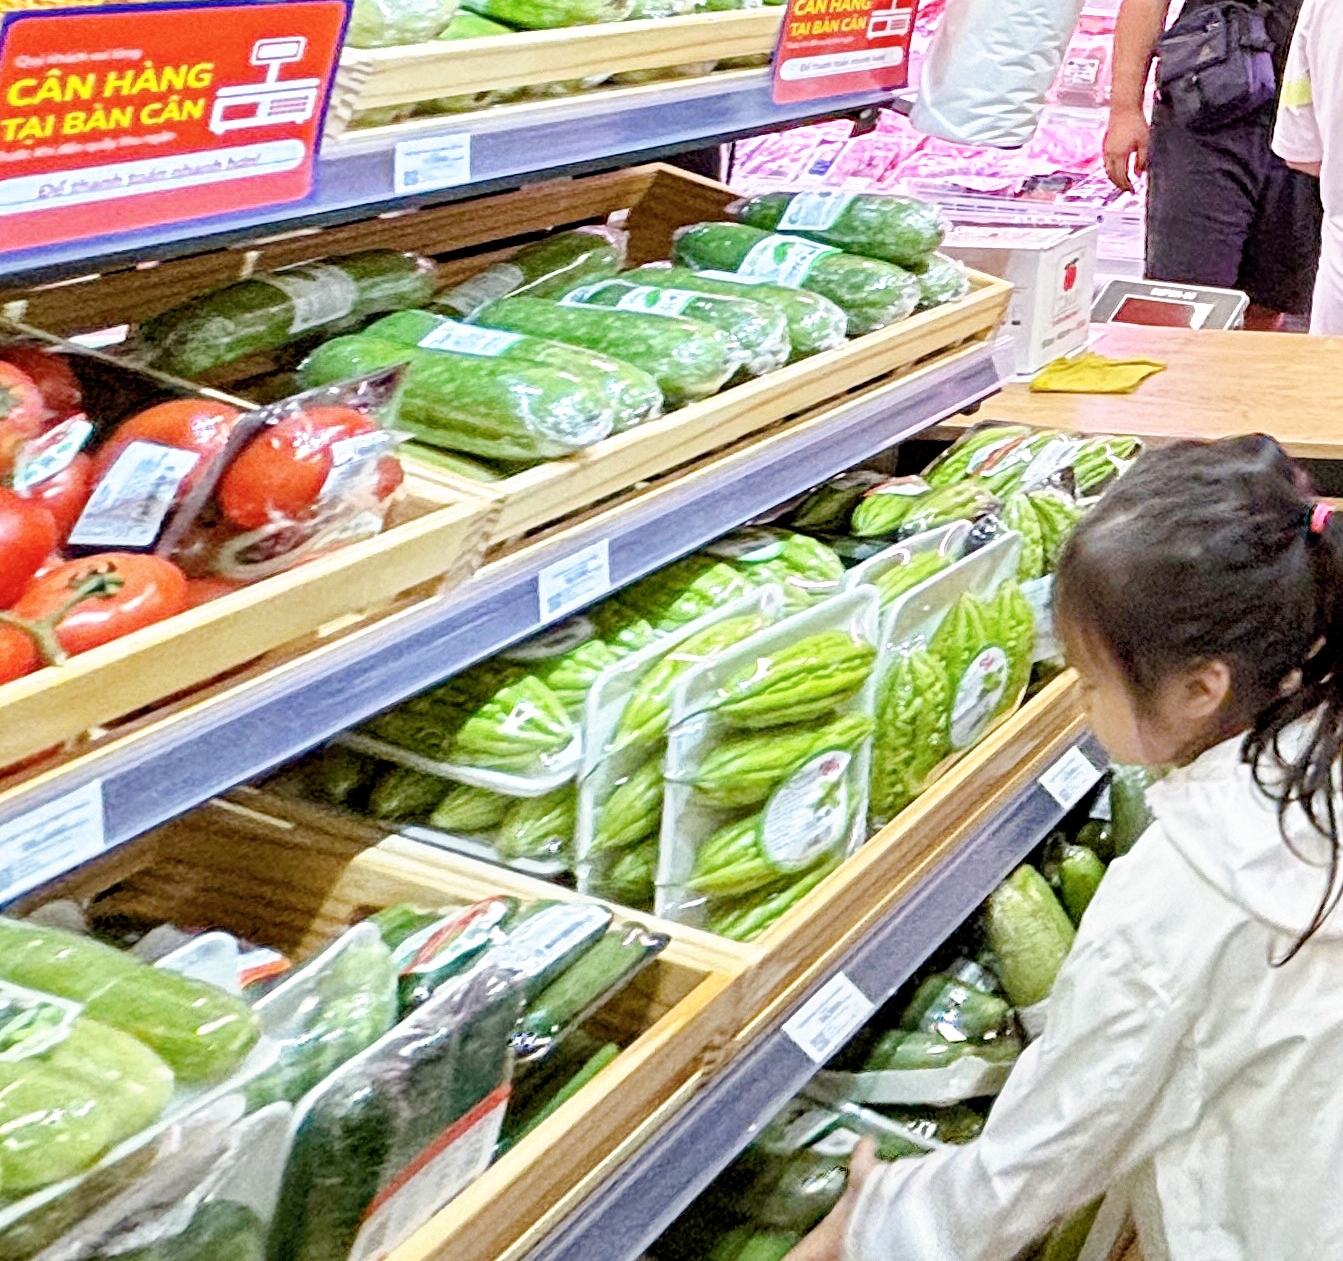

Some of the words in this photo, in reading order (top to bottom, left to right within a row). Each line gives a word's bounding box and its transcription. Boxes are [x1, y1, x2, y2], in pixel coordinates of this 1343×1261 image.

[812, 17, 840, 34] BÀN
[841, 14, 868, 31] CÂN
[6, 68, 96, 107] CÂN
[102, 60, 214, 98] HÀNG
[0, 114, 55, 145] TẠI
[62, 103, 134, 135] BÀN
[140, 94, 206, 126] CÂN
